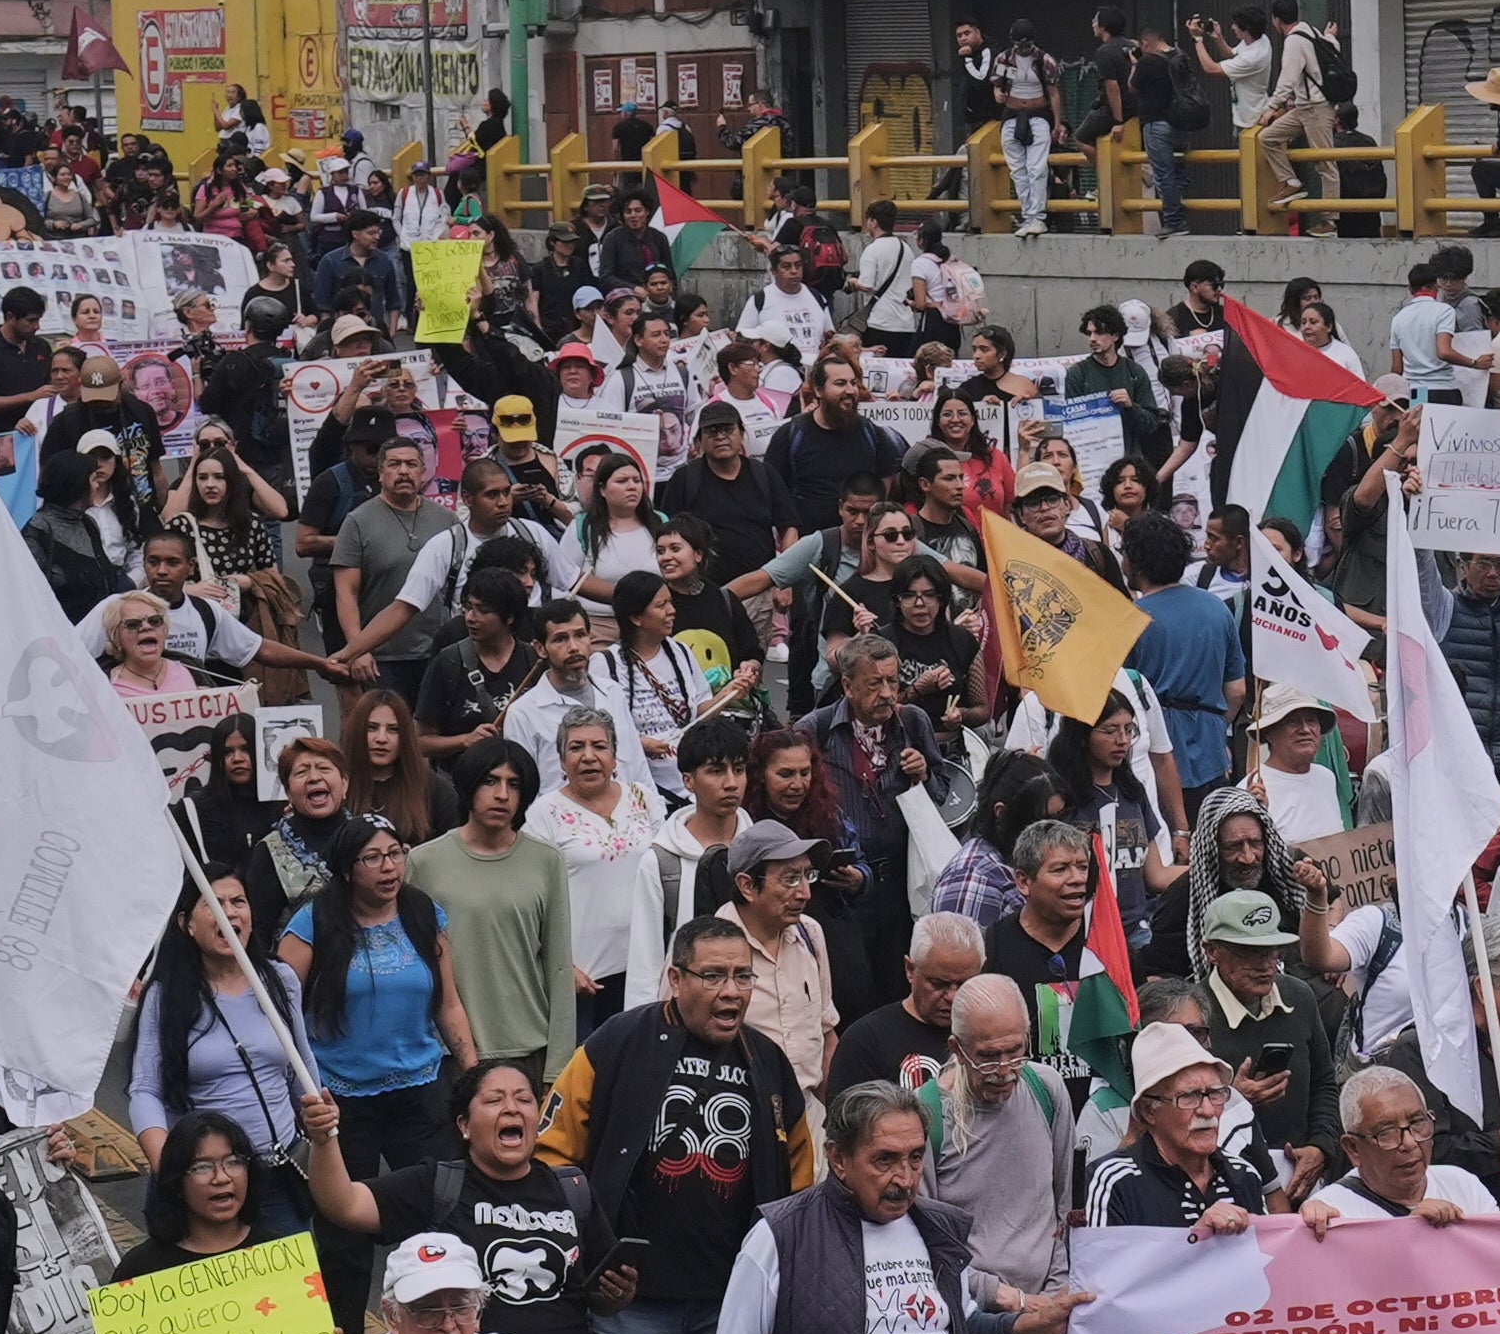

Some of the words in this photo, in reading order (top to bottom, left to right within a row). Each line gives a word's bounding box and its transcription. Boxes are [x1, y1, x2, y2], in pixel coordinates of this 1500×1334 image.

[1413, 495, 1480, 531] ¡Fuera
[1253, 596, 1311, 627] AÑOS
[150, 1276, 177, 1305] la
[178, 1237, 306, 1298] GENERACIÓN
[865, 1260, 903, 1273] octubre
[905, 1260, 915, 1269] de
[1225, 1308, 1274, 1327] 02
[1287, 1302, 1336, 1322] DE
